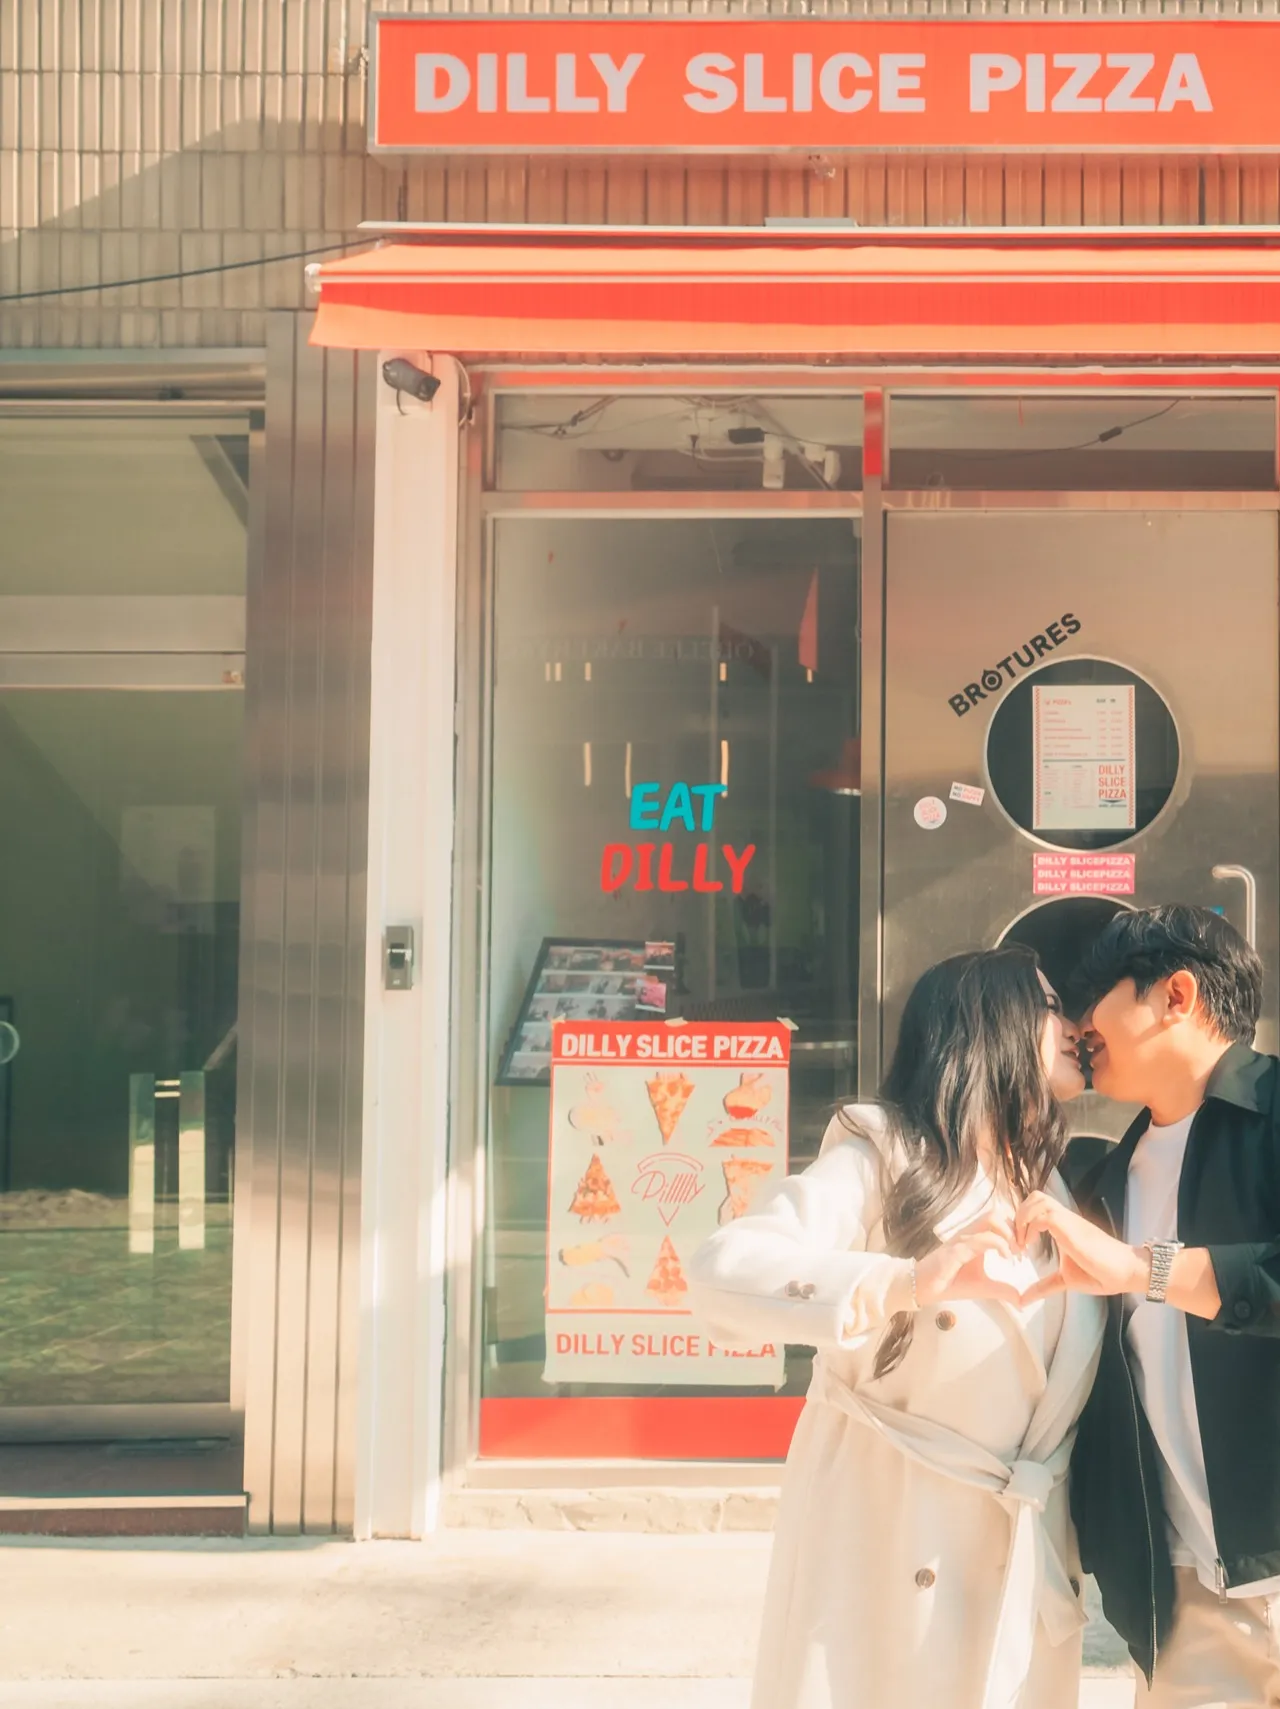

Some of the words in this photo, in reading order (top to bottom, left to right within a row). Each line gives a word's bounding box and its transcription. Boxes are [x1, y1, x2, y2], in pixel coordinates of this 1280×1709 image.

[413, 52, 646, 114] DILLY
[683, 52, 926, 114] SLICE
[967, 52, 1215, 114] PIZZA
[947, 612, 1082, 718] BROTURES
[1098, 764, 1126, 775] DILLY
[1098, 776, 1126, 787] SLICE
[1098, 788, 1127, 799] PIZZA
[628, 781, 729, 832] EAT
[600, 841, 757, 894] DILLY
[1037, 856, 1067, 866] DILLY
[1037, 869, 1067, 879] DILLY
[1037, 882, 1067, 891] DILLY
[561, 1033, 633, 1058] DILLY
[636, 1034, 708, 1058] SLICE
[713, 1035, 784, 1059] PIZZA
[556, 1333, 625, 1356] DILLY
[631, 1334, 700, 1357] SLICE
